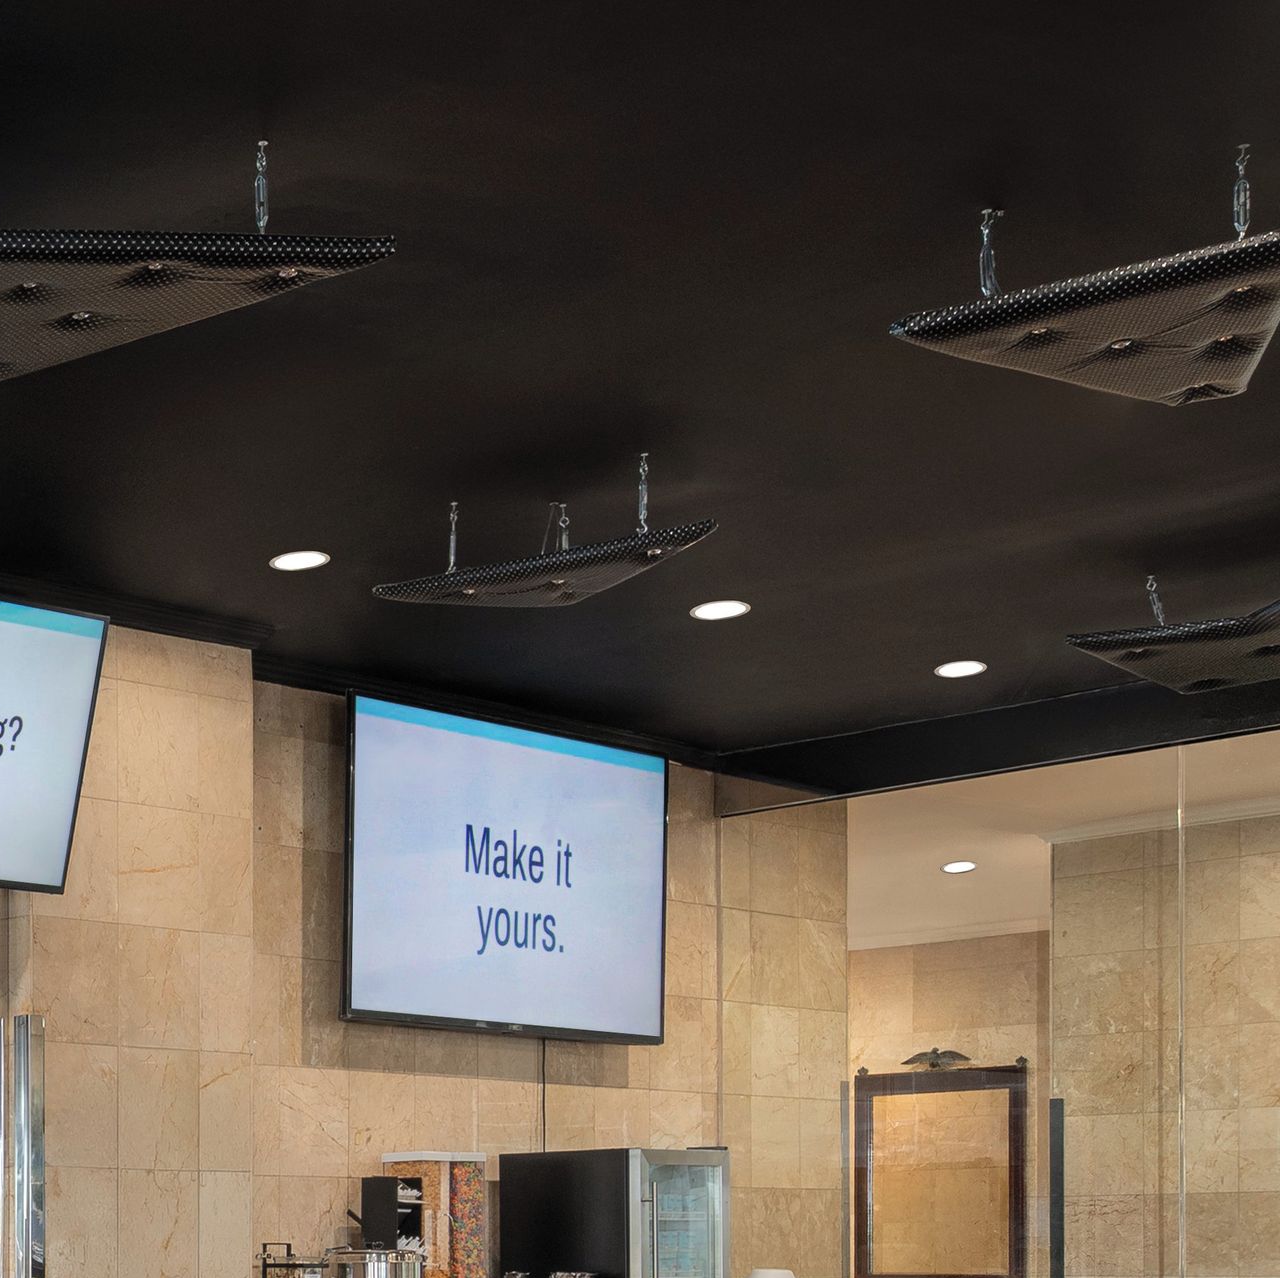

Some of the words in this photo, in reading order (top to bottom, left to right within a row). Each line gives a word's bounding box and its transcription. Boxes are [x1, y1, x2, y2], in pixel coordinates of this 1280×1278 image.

[464, 823, 545, 884] Make
[556, 839, 573, 888] it
[476, 905, 565, 956] yours.
